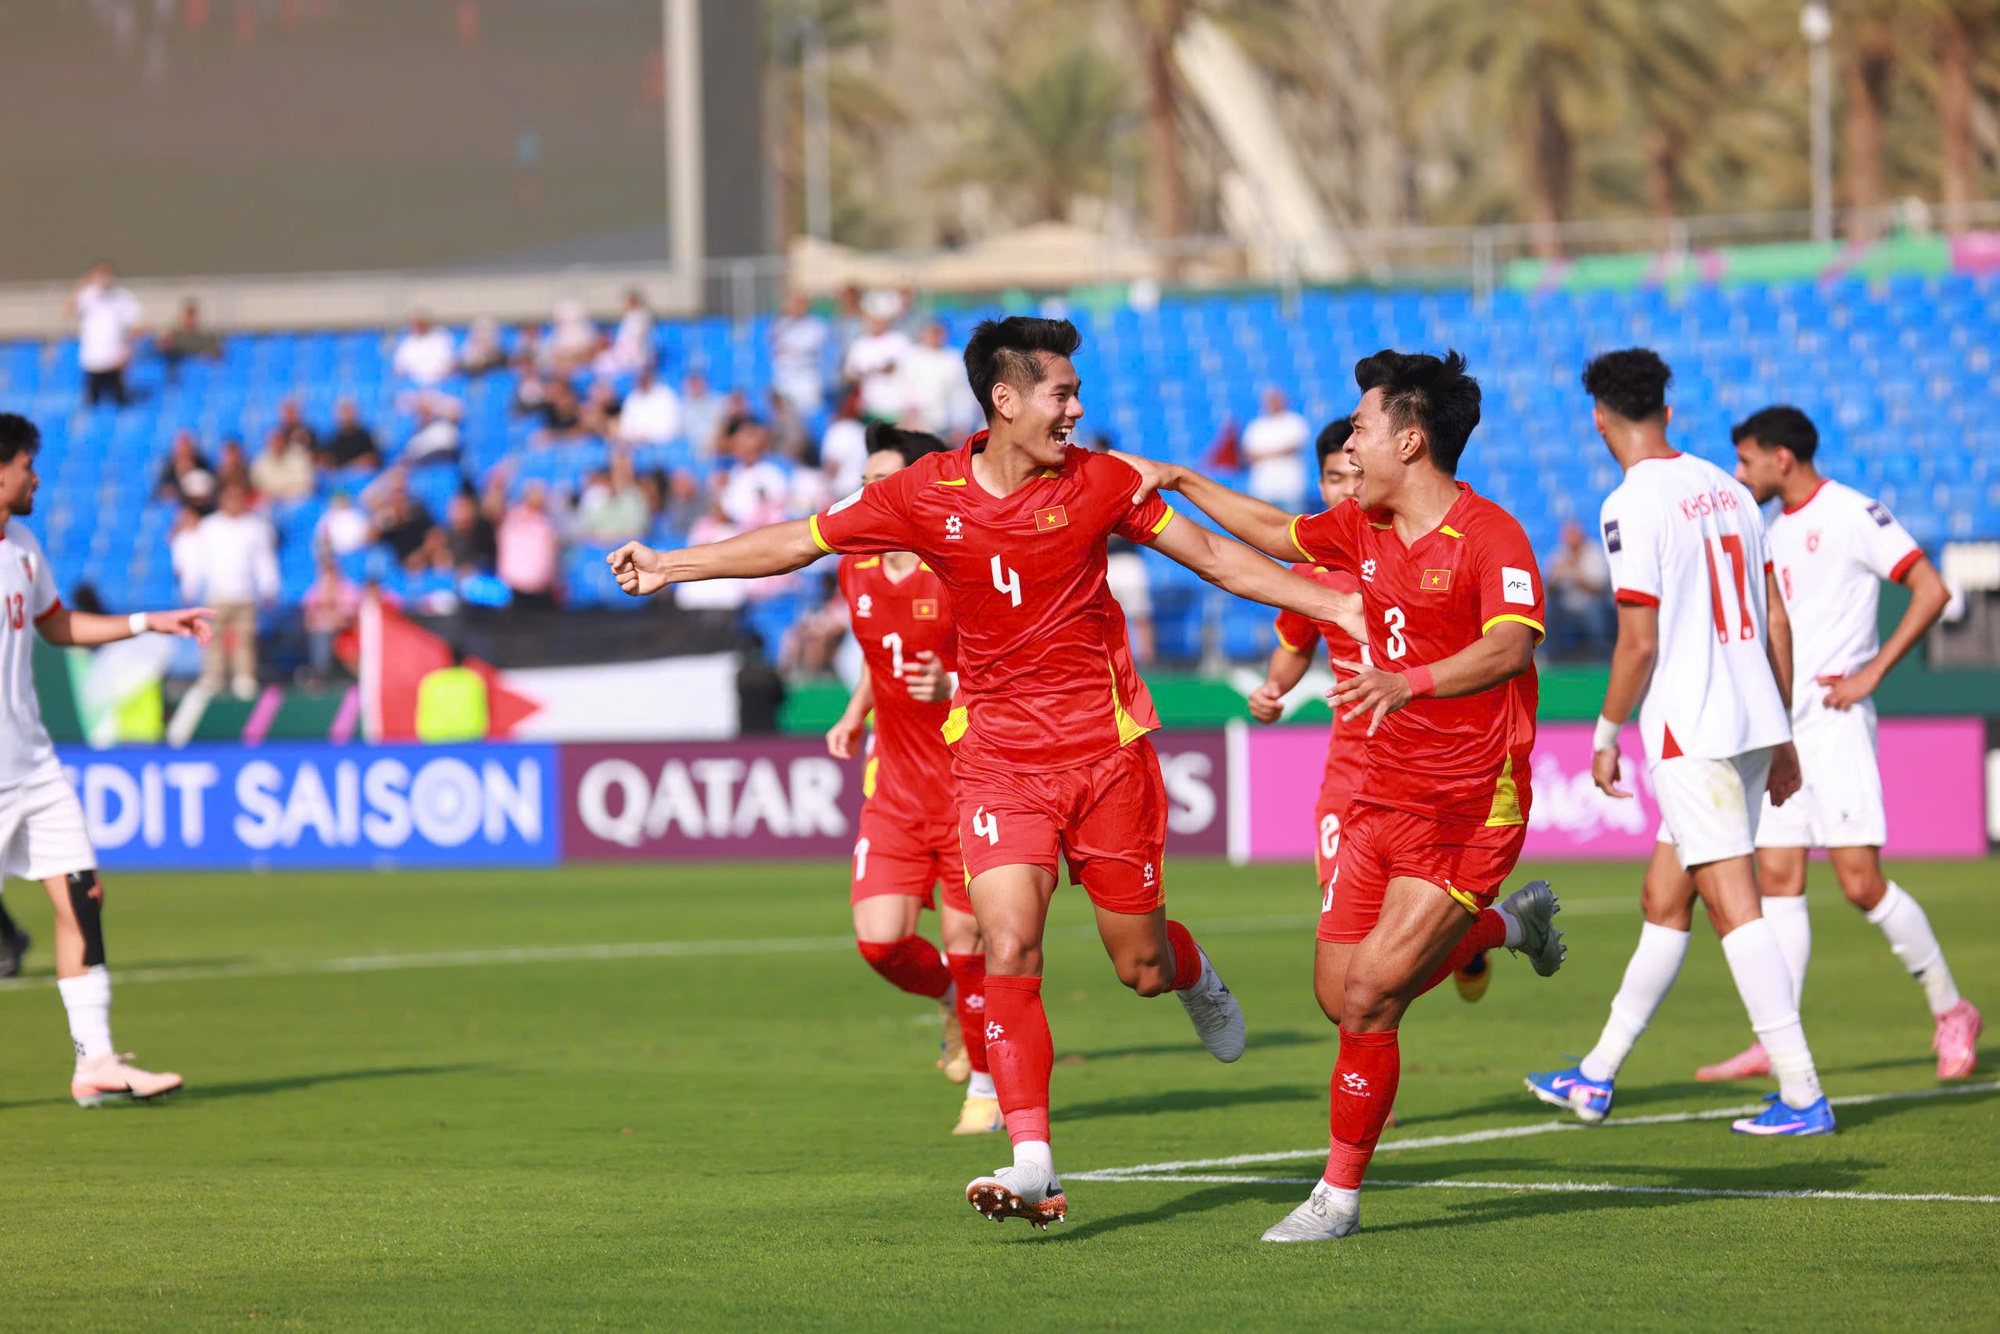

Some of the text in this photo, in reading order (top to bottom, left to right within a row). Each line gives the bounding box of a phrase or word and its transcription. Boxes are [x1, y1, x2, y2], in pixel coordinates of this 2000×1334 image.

[990, 554, 1023, 608] 4
[1507, 580, 1528, 591] AFC
[1705, 534, 1754, 644] 17
[6, 593, 24, 630] 13
[1384, 606, 1407, 661] 3
[233, 756, 544, 850] SAISON
[577, 757, 847, 847] QATAR
[972, 805, 999, 846] 4
